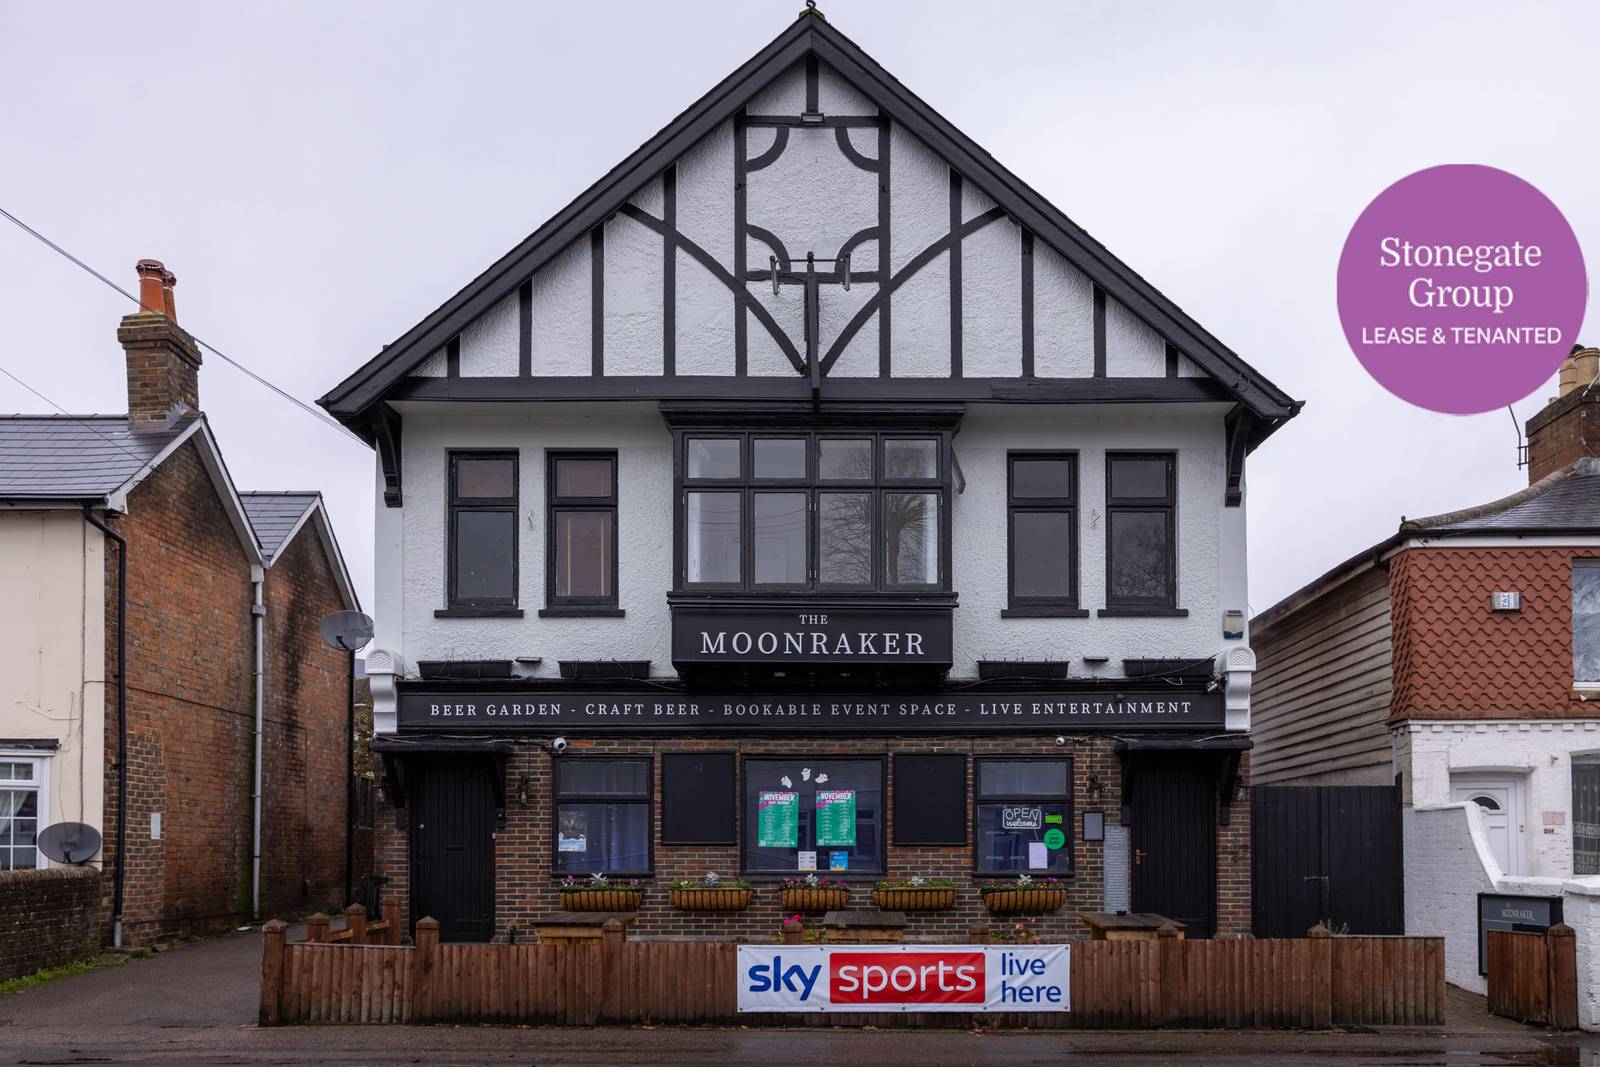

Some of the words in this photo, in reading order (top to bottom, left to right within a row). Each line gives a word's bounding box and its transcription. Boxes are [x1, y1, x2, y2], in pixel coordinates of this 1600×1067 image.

[799, 614, 829, 625] THE
[700, 631, 925, 656] MOONRAKER
[430, 704, 477, 716] BEER
[486, 703, 562, 716] GARDEN
[585, 703, 645, 716] CRAFT
[654, 703, 700, 716] BEER
[723, 703, 822, 716] BOOKABLE
[831, 703, 890, 716] EVENT
[899, 703, 957, 716] SPACE
[980, 702, 1023, 716] LIVE
[1032, 701, 1192, 715] ENTERTAINMENT
[764, 793, 795, 801] NOVEMBER
[820, 792, 852, 800] NOVEMBER
[1005, 807, 1039, 821] OPEN
[1001, 952, 1046, 976] live
[749, 955, 822, 1001] sky
[838, 960, 977, 1000] sports
[1001, 980, 1062, 1003] here
